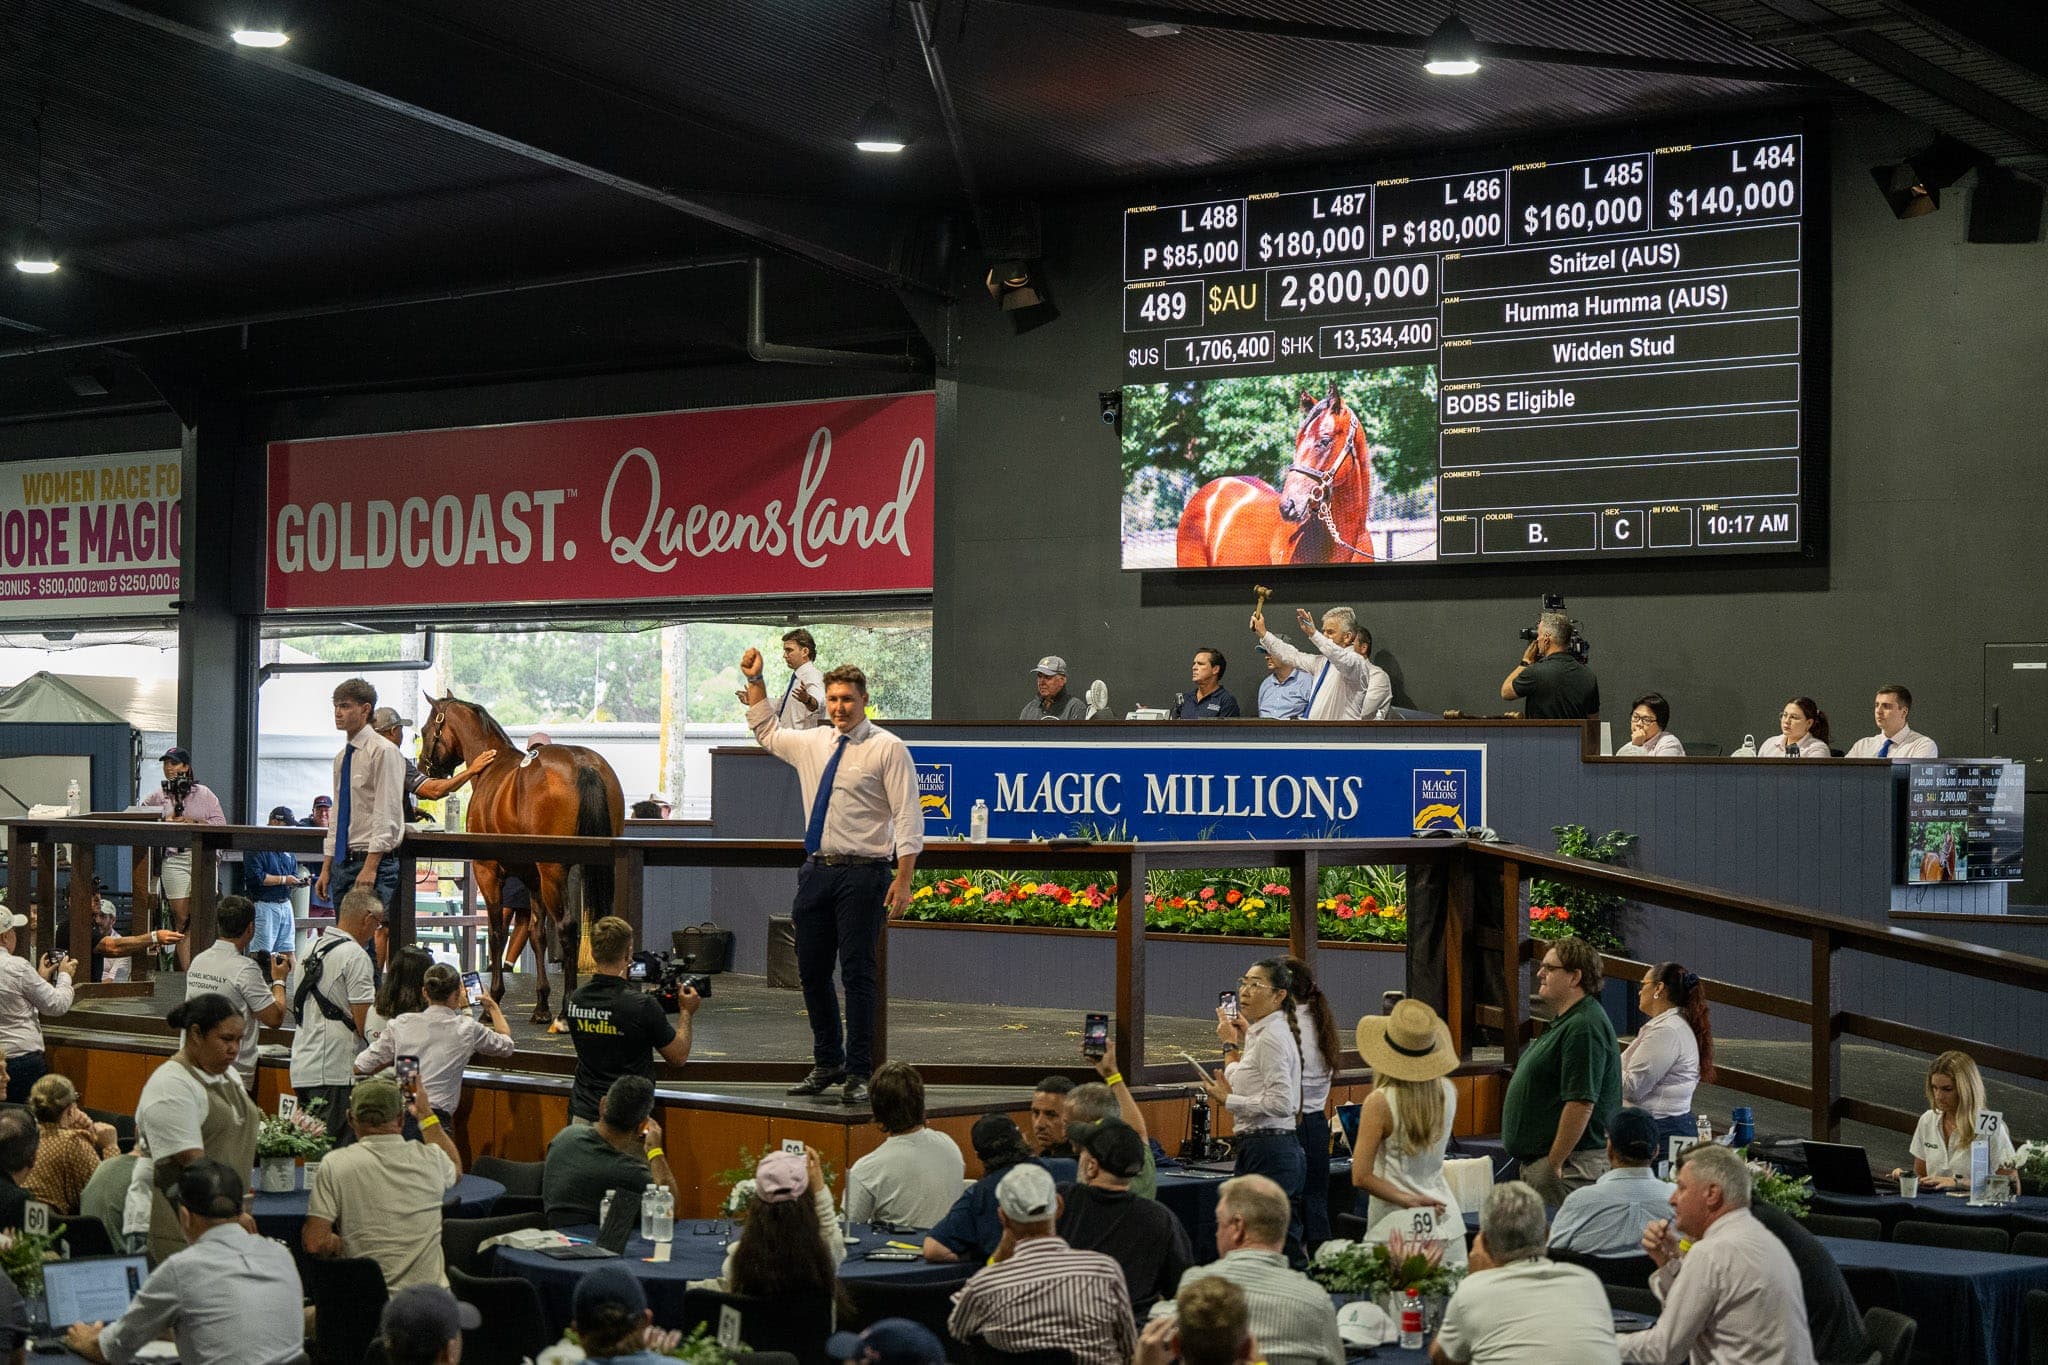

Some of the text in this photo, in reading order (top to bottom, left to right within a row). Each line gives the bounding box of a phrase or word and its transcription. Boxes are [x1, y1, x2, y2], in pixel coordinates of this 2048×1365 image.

[1655, 145, 1692, 155] PREVIOUS
[1732, 144, 1796, 173] L 484
[1512, 162, 1547, 171] PREVIOUS
[1584, 161, 1643, 190] L 485
[1376, 178, 1409, 187] PREVIOUS
[1445, 178, 1501, 205] L 486
[1127, 205, 1157, 213] PREVIOUS
[1249, 192, 1280, 200] PREVIOUS
[1313, 193, 1366, 218] L 487
[1668, 179, 1795, 221] $140,000
[1181, 204, 1238, 232] L 488
[1524, 195, 1643, 236] $160,000
[1382, 213, 1501, 247] P $180,000
[1144, 240, 1239, 270] P $85,000
[1259, 225, 1365, 262] $180,000
[1549, 243, 1681, 275] Snitzel (AUS)
[1208, 284, 1258, 314] $AU
[1280, 263, 1430, 312] 2,800,000
[1140, 291, 1187, 323] 489
[1505, 284, 1728, 323] Humma Humma (AUS)
[1129, 336, 1270, 367] $US 1,706,400
[1281, 323, 1432, 355] $HK 13,534,400
[1553, 335, 1675, 363] Widden Stud
[1443, 383, 1481, 391] COMMENTS
[1446, 389, 1576, 415] BOBS Eligible
[1443, 427, 1481, 435] COMMENTS
[22, 470, 95, 505] WOMEN
[101, 465, 149, 500] RACE
[1443, 470, 1481, 478] COMMENTS
[602, 426, 925, 573] Queensland
[1661, 505, 1681, 513] FOAL
[1528, 523, 1549, 543] B.
[1615, 518, 1630, 540] C
[1707, 514, 1789, 535] 10:17 AM
[0, 508, 70, 568] ORE
[0, 579, 31, 596] BONUS
[39, 577, 87, 597] $500,000
[109, 576, 117, 592] &
[119, 573, 170, 593] $250,000
[993, 771, 1364, 822] MAGIC MILLIONS
[1422, 780, 1457, 792] MAGIC
[568, 1002, 612, 1020] Hunter
[282, 1098, 295, 1116] 67
[1980, 1114, 1998, 1131] 73
[29, 1207, 45, 1230] 60
[1414, 1212, 1433, 1234] 69
